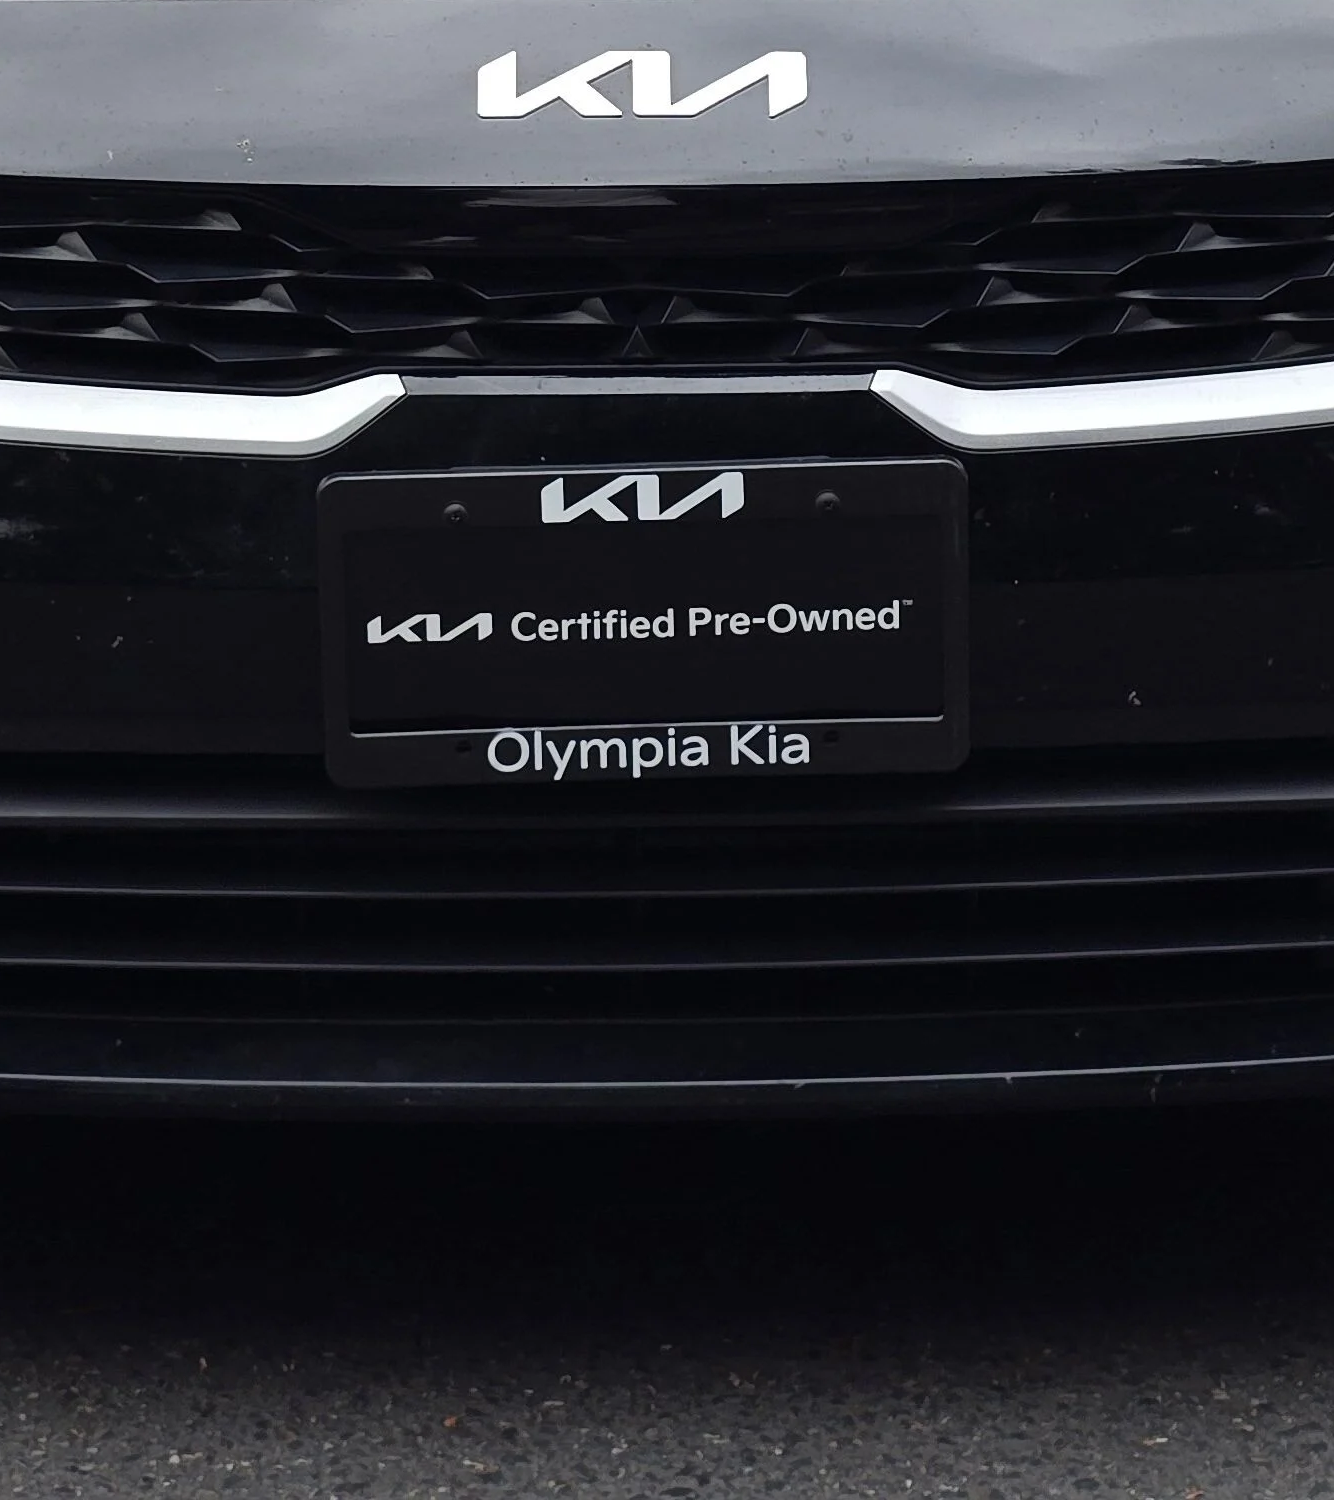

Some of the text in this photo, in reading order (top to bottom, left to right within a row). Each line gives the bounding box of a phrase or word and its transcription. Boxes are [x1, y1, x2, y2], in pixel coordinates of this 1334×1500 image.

[477, 50, 807, 119] KIA
[540, 471, 745, 524] KIA
[367, 613, 492, 643] KIA
[511, 608, 674, 641] Certified
[487, 724, 811, 780] Olympia Kia
